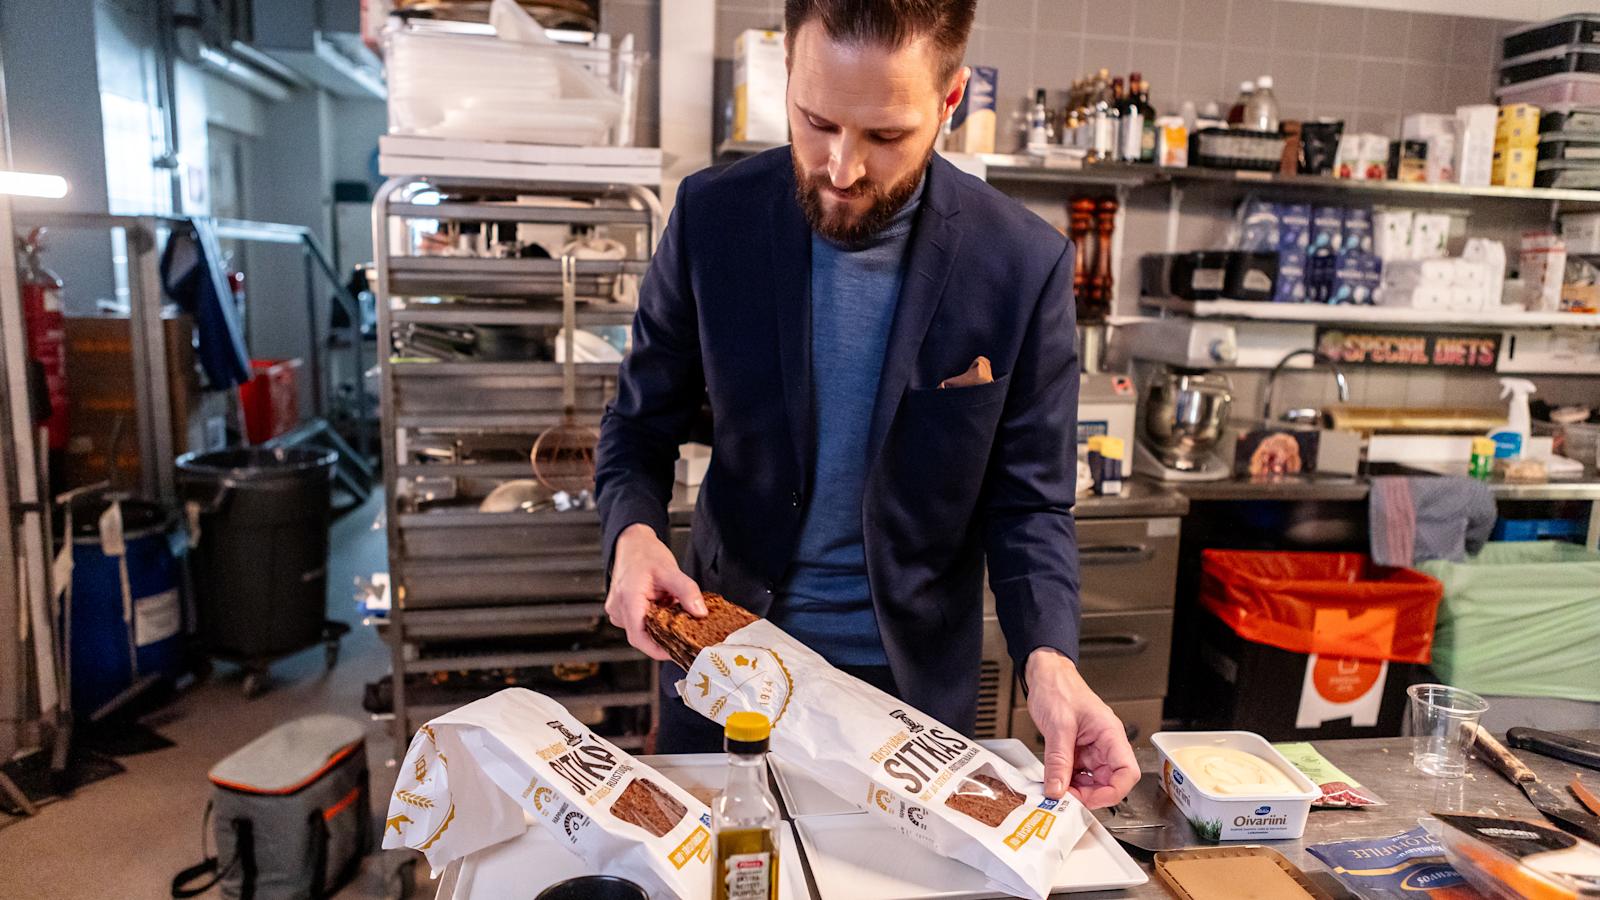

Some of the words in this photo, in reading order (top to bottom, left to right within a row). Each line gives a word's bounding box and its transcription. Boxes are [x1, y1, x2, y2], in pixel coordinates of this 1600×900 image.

[1343, 334, 1429, 364] SPECIAL
[1433, 337, 1495, 366] DIETS
[760, 680, 773, 705] 1924
[549, 733, 618, 796] SITKA
[883, 728, 968, 794] SITKAS
[1233, 814, 1287, 827] Oivariini
